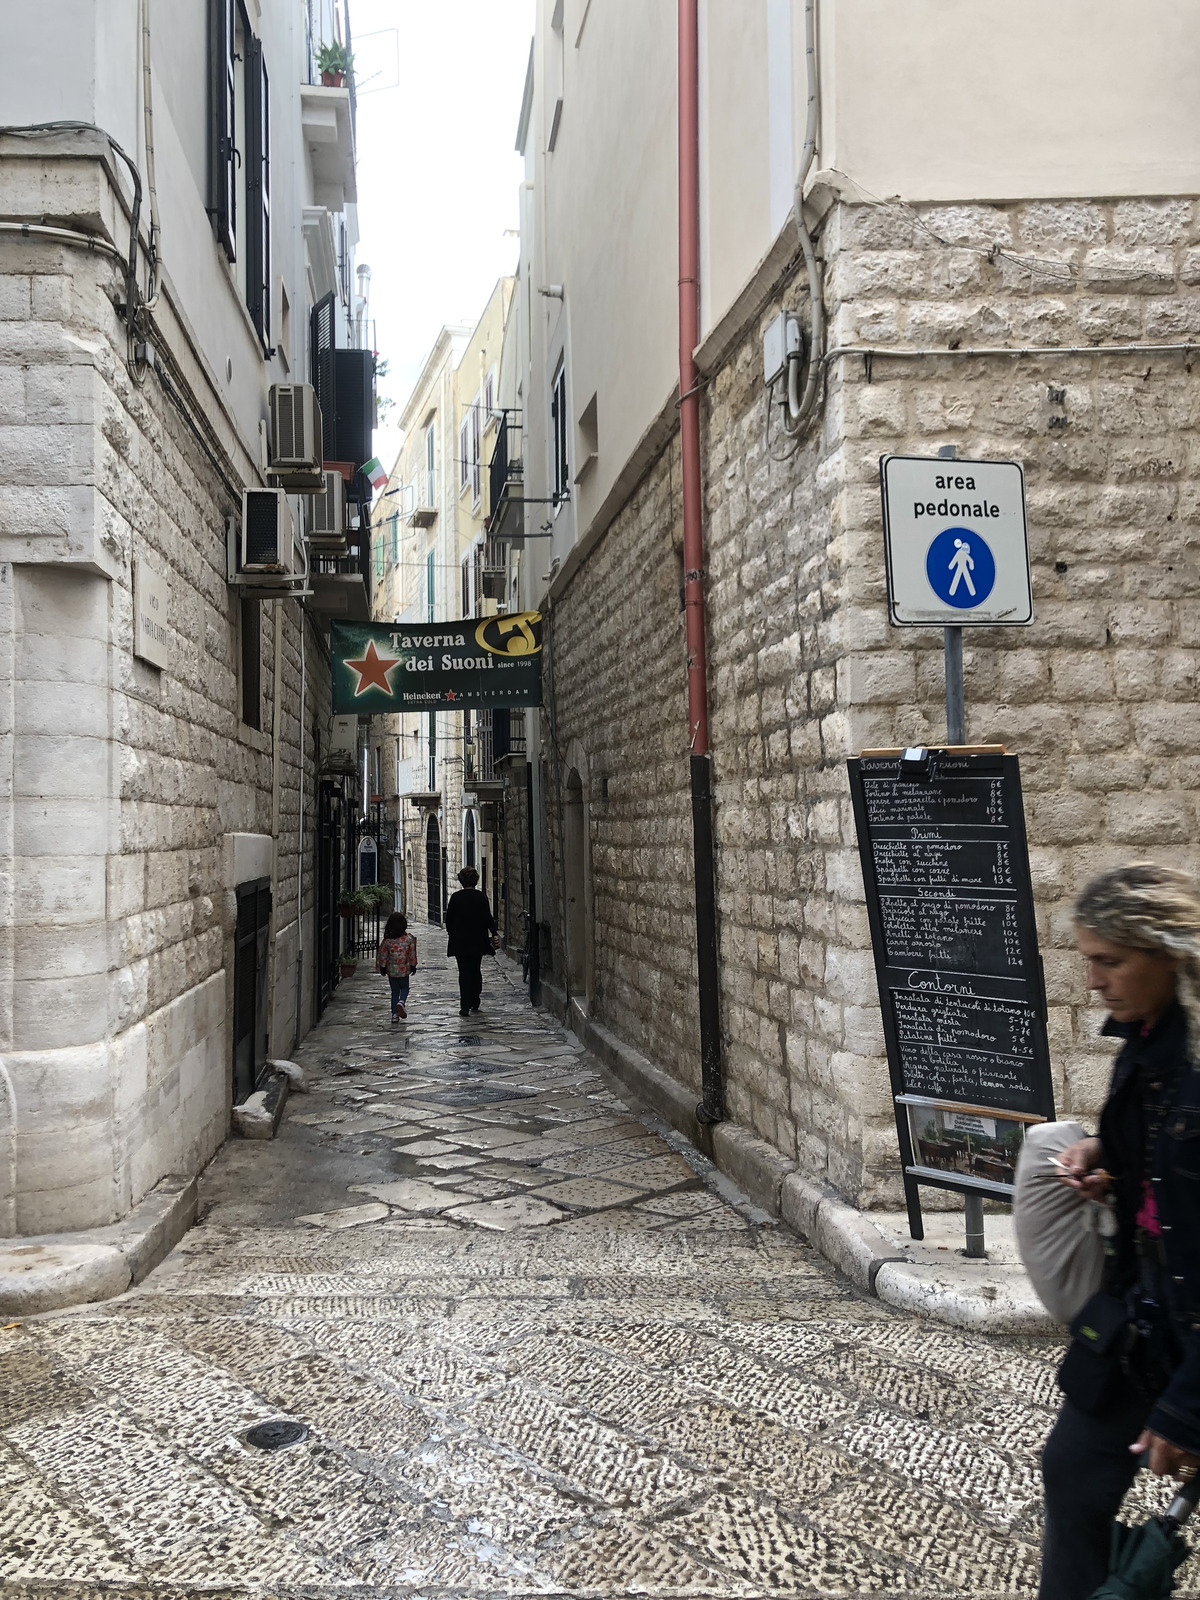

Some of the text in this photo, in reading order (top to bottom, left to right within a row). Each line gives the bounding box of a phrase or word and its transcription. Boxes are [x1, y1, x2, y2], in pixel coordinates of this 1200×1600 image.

[935, 475, 976, 490] area
[913, 499, 1000, 519] pedonale
[389, 632, 466, 648] Taverna
[405, 655, 434, 672] dei
[441, 652, 495, 671] Suoni
[517, 660, 532, 668] 1998
[403, 689, 529, 700] Heineken AMSTERDAM
[860, 759, 902, 770] Tavern
[942, 794, 978, 806] pomodoro
[911, 827, 942, 840] Primi
[926, 843, 962, 852] pomodoro
[918, 887, 956, 897] Secondi
[955, 901, 996, 912] pomodoro
[908, 970, 976, 996] Contorni
[893, 991, 931, 1003] Insalata
[934, 996, 943, 1005] di
[895, 1001, 928, 1013] Verdura
[896, 1010, 932, 1023] Insalata
[898, 1020, 935, 1032] Insalata
[951, 1028, 997, 1042] pomodoro
[899, 1030, 934, 1041] Patatine
[900, 1045, 917, 1054] Vino
[943, 1051, 962, 1059] casa
[901, 1053, 918, 1061] Vino
[934, 1064, 968, 1075] naturale
[980, 1077, 1006, 1089] lemon
